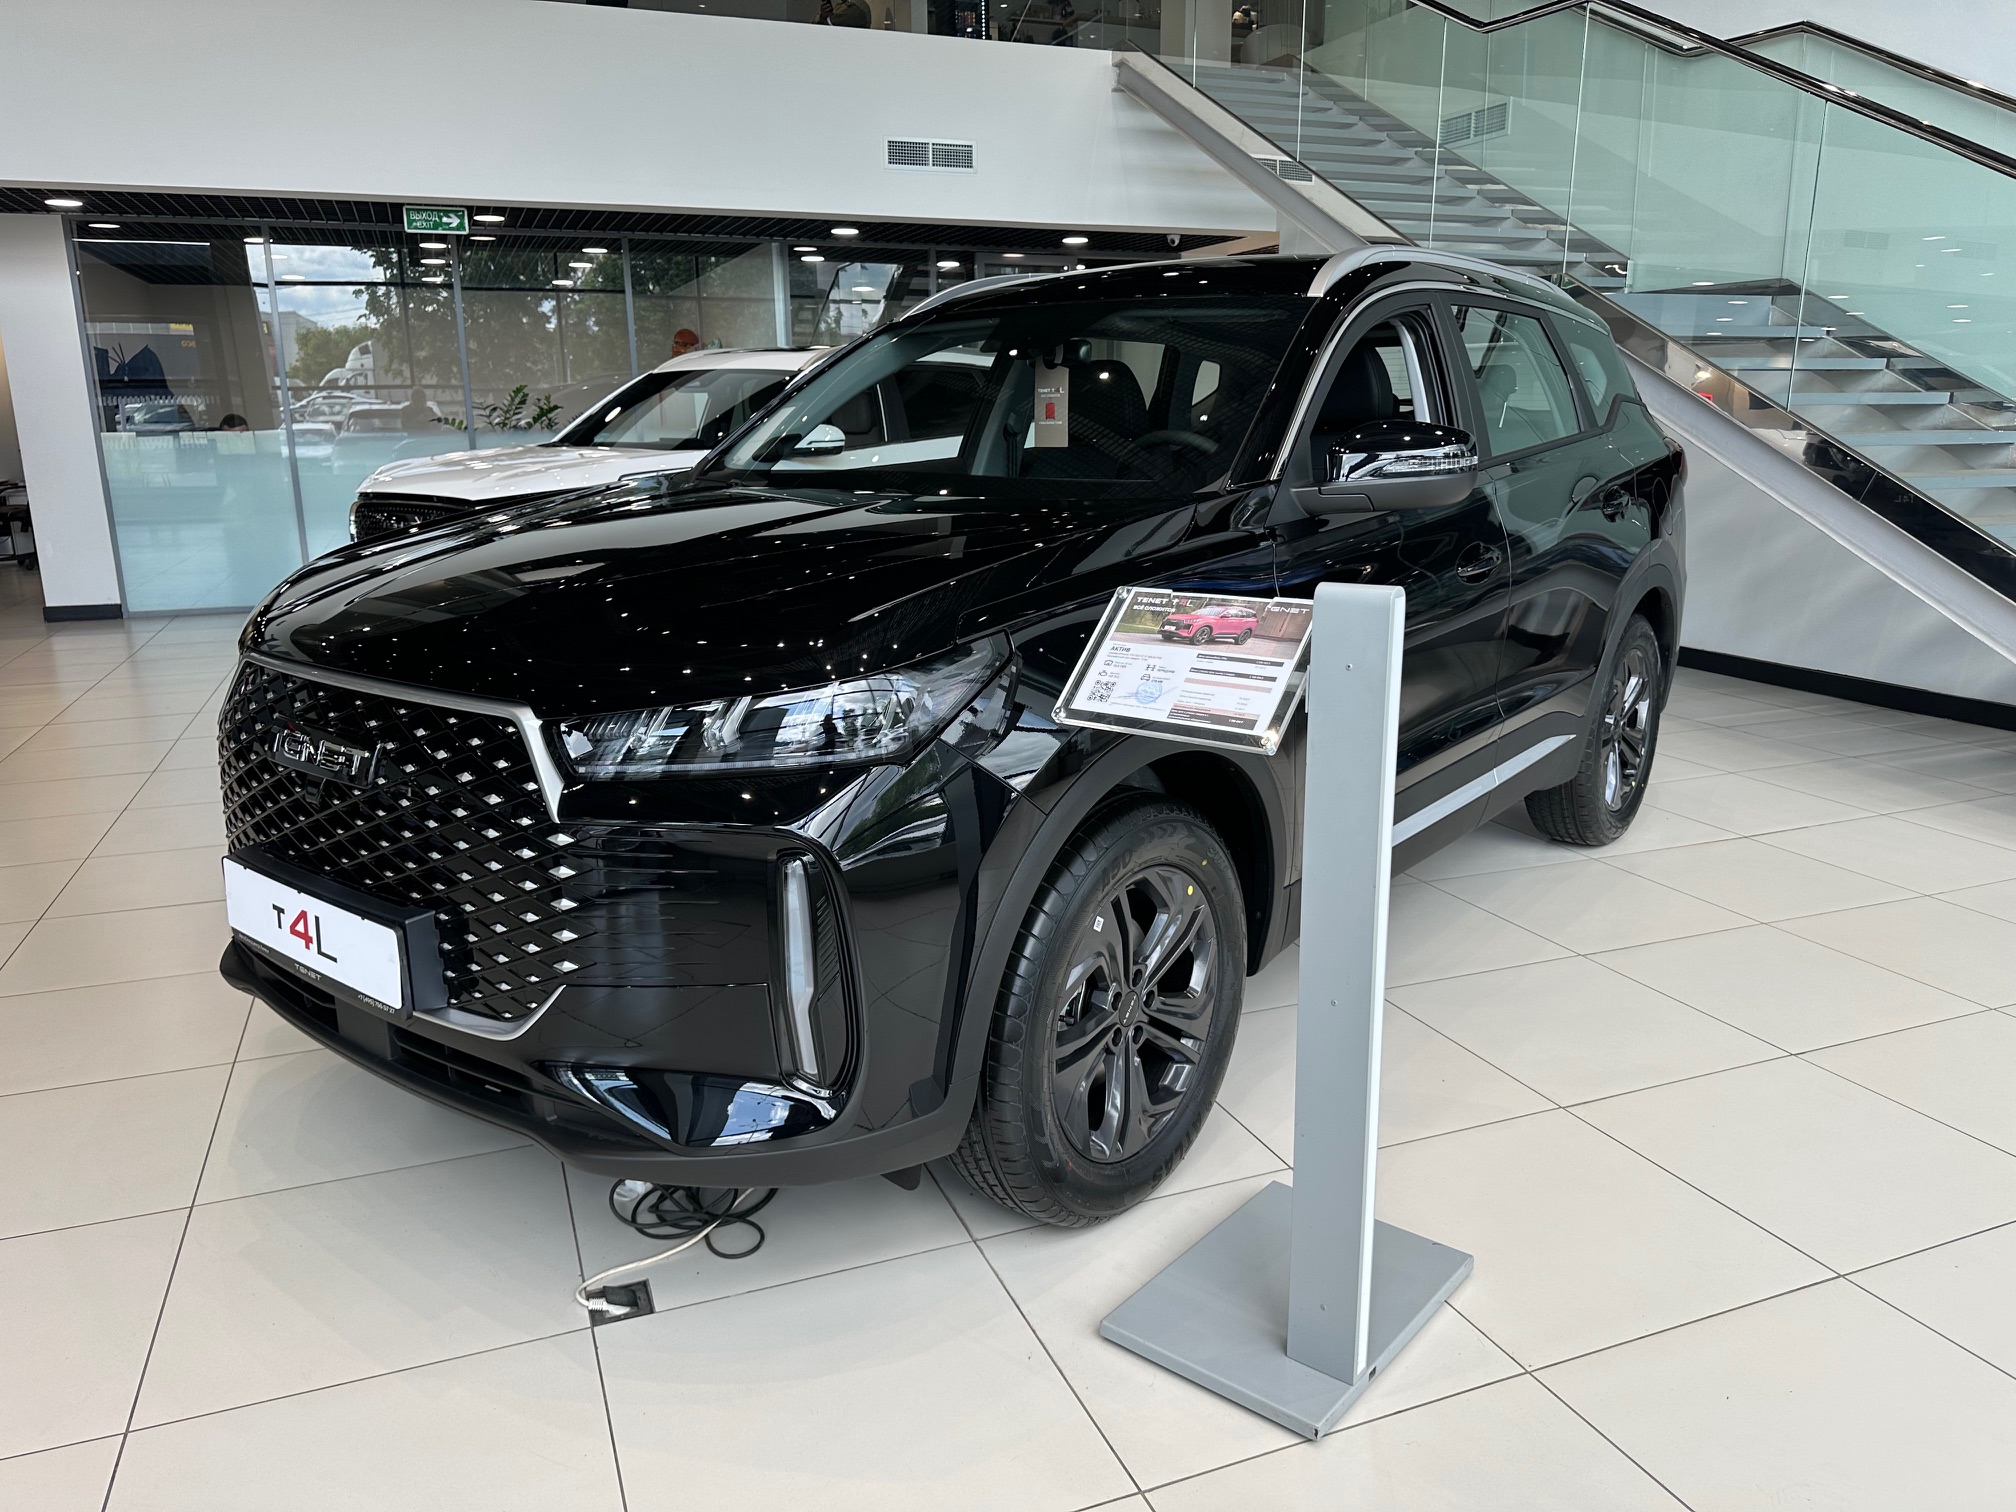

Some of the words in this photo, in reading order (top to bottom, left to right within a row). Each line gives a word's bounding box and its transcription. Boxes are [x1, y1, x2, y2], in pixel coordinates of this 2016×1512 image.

[409, 210, 439, 222] ВЫХОД
[417, 220, 434, 229] EXIT
[1137, 596, 1169, 604] TENET
[272, 724, 370, 775] TENET
[294, 962, 322, 982] TENET
